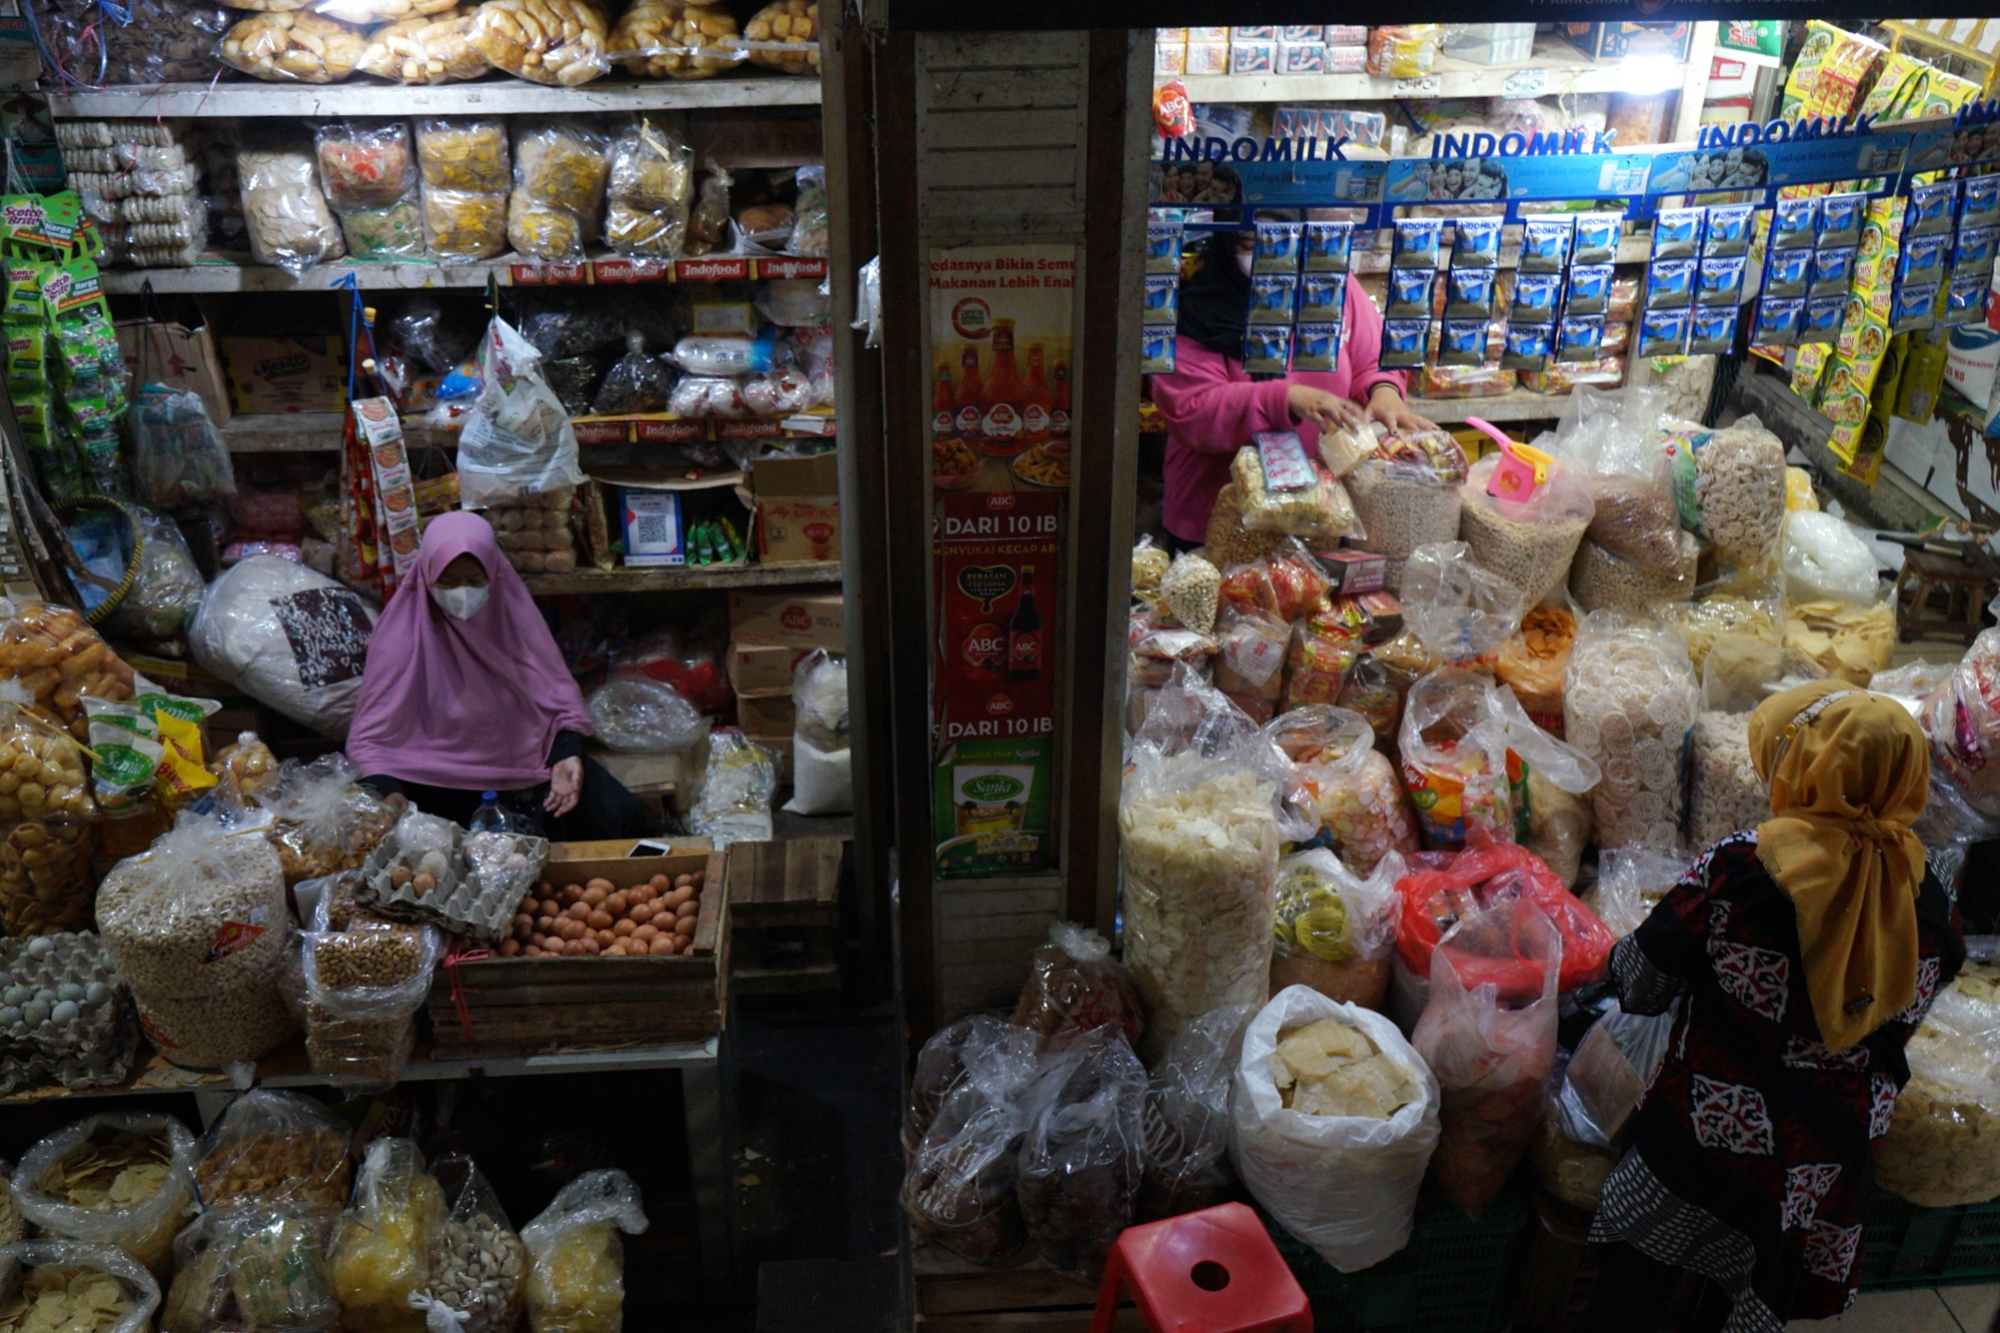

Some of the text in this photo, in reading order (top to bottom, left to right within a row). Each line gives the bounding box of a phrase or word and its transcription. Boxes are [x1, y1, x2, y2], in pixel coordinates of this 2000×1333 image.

[1160, 99, 1184, 116] ABC
[1954, 99, 2000, 128] IN
[1698, 112, 1879, 150] INDOMILK
[1163, 135, 1350, 161] INDOMILK
[1431, 128, 1617, 158] INDOMILK
[4, 206, 42, 217] Scotch
[8, 217, 40, 225] Brite
[685, 262, 741, 279] Indofood
[767, 260, 822, 277] Indfood
[931, 259, 992, 273] edasnya
[996, 258, 1034, 270] Bikin
[44, 274, 70, 294] Scotch
[929, 276, 996, 289] Makanan
[1000, 276, 1040, 288] Lebih
[992, 412, 1012, 422] ABC
[646, 422, 698, 438] Indofood
[990, 496, 1012, 506] ABC
[946, 516, 999, 534] DARI
[1008, 515, 1031, 534] 10
[1036, 514, 1058, 532] IB
[998, 544, 1037, 555] KECAP
[783, 614, 810, 626] ABC
[968, 638, 1004, 652] ABC
[1015, 642, 1036, 652] ABC
[990, 701, 1010, 710] ABC
[949, 720, 998, 738] DARI
[1006, 718, 1028, 734] 10
[1033, 717, 1054, 732] IB
[1014, 748, 1040, 760] Sania
[973, 780, 1012, 796] Sania
[932, 1200, 956, 1222] KG
